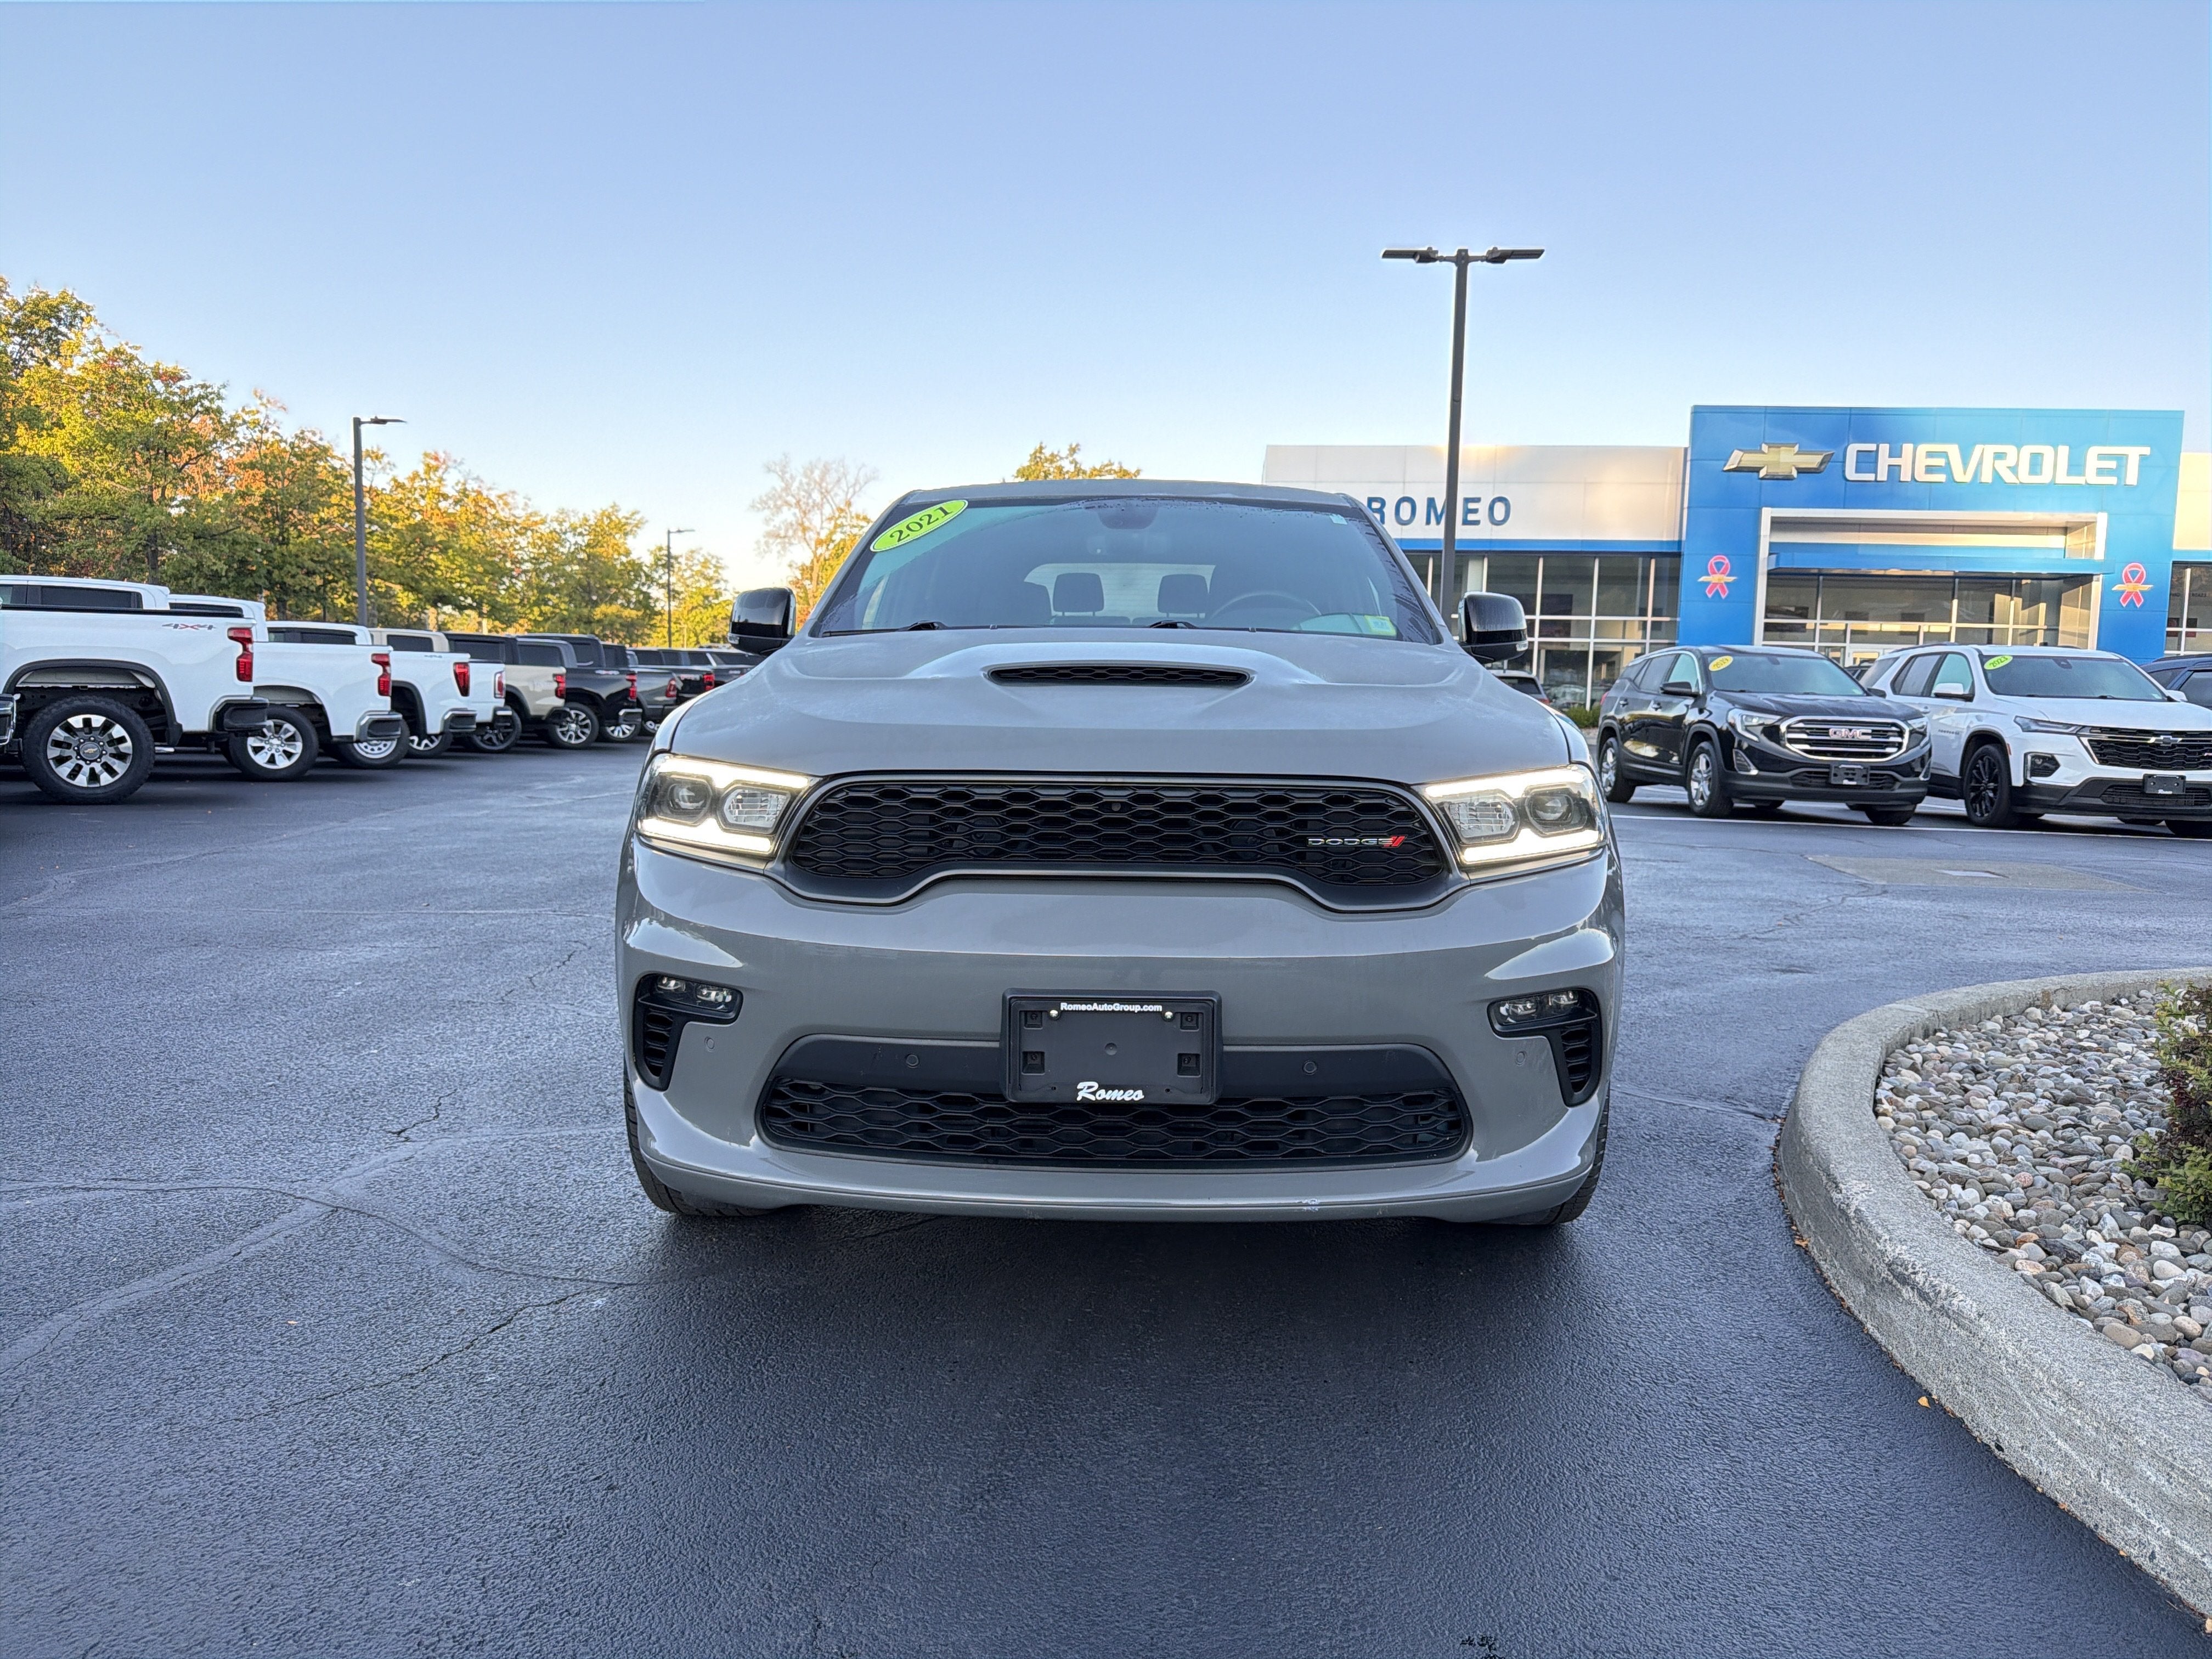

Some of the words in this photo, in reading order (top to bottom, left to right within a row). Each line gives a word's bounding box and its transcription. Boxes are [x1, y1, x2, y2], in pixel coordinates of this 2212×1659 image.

[1845, 443, 2151, 486] CHEVROLET
[1367, 496, 1511, 526] ROMEO
[889, 506, 953, 543] 2021
[1829, 728, 1872, 740] GMC
[1307, 838, 1394, 847] DODGE
[1060, 1002, 1163, 1013] RomeoAutoGroup.com
[1076, 1081, 1145, 1101] Romeo
